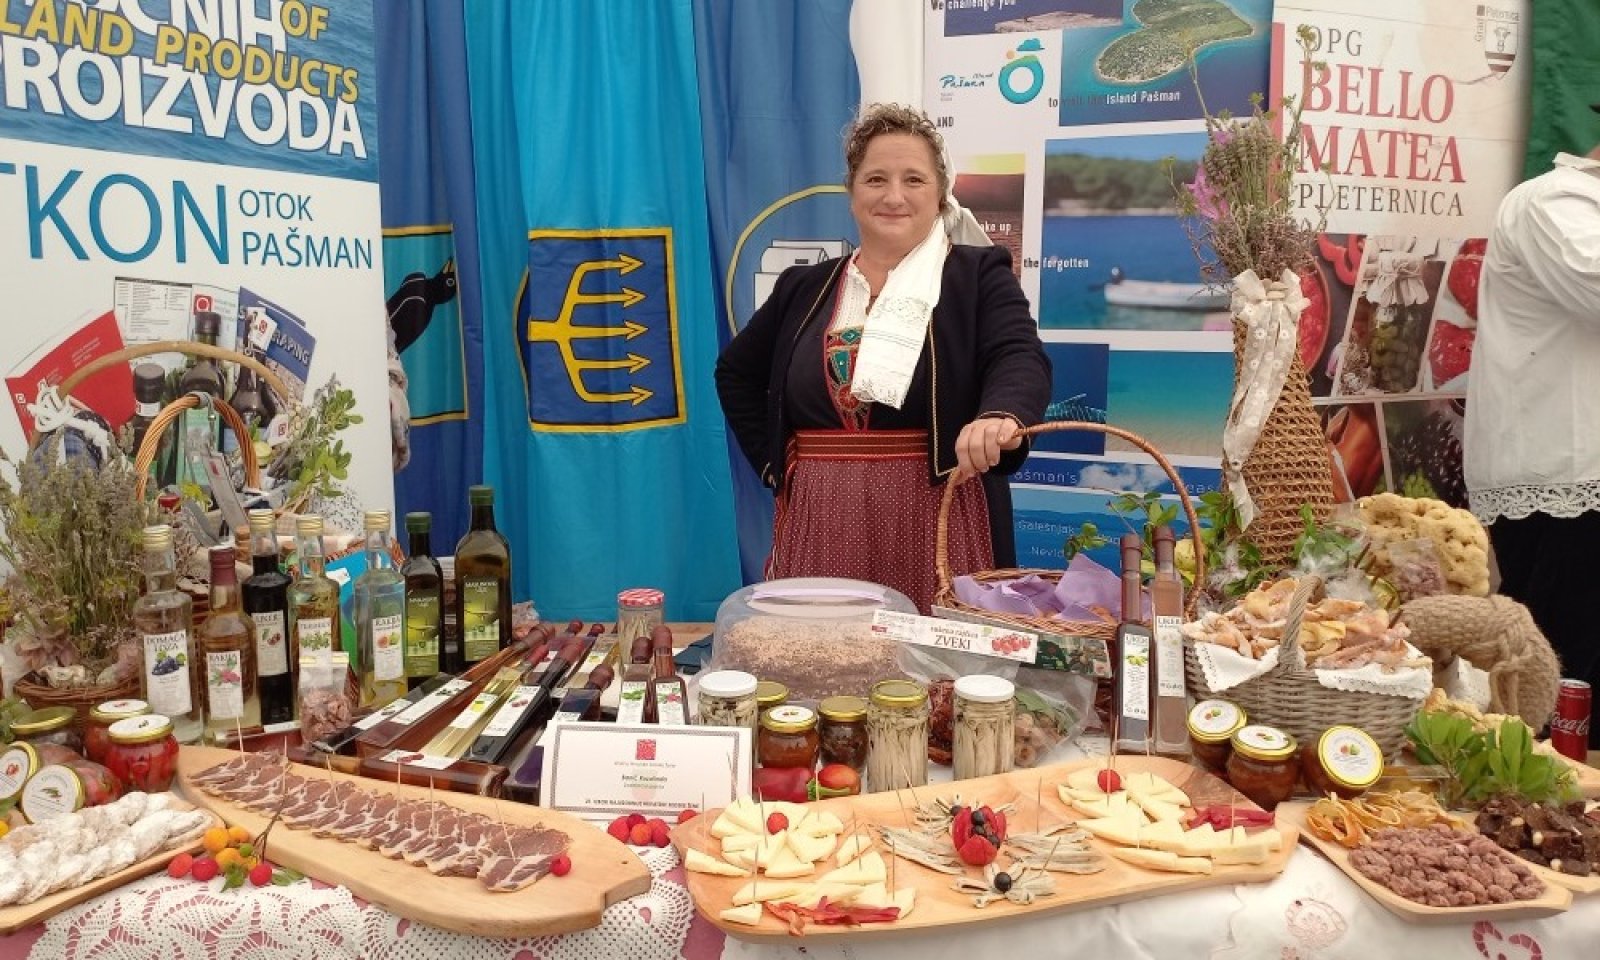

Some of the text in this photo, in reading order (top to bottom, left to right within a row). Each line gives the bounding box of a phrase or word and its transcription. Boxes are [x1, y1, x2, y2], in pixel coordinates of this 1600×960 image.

[281, 0, 329, 41] OF
[0, 0, 359, 104] LAND PRODUCTS
[0, 35, 368, 160] ROIZVODA
[1107, 92, 1137, 105] Island
[1140, 90, 1180, 103] Pašman
[1299, 60, 1454, 124] BELLO
[1295, 124, 1467, 183] MATEA
[0, 162, 231, 265] KON
[238, 189, 314, 222] OTOK
[1298, 183, 1465, 217] PLETERNICA
[980, 220, 1012, 236] ake up
[241, 227, 373, 269] PAŠMAN
[1023, 257, 1089, 272] the forgotten
[1013, 468, 1078, 484] ašman's
[934, 635, 971, 650] ZVEKI
